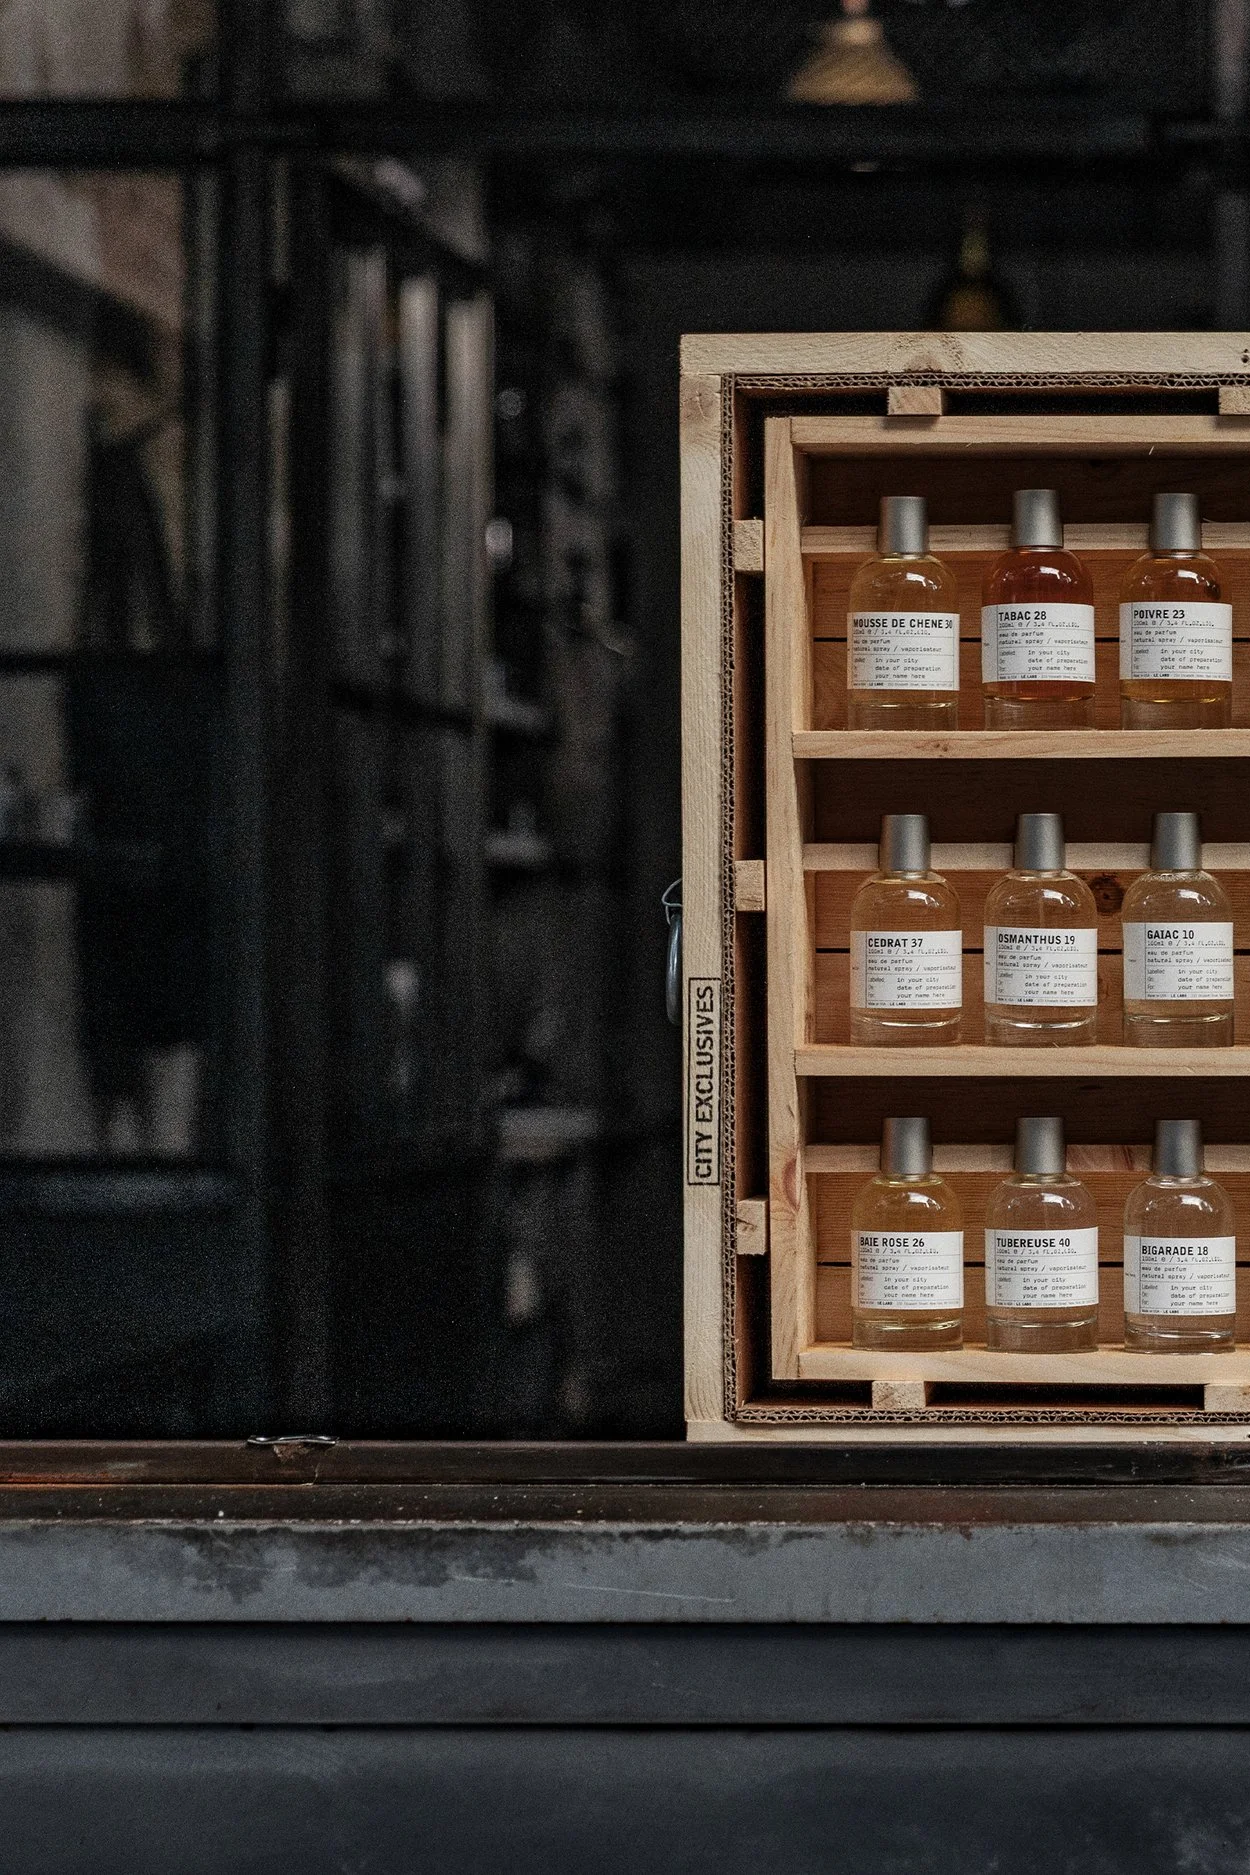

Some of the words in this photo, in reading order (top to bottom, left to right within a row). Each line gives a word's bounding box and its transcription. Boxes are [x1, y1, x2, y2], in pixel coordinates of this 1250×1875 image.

[999, 611, 1030, 621] TABAC
[1034, 611, 1046, 620] 28
[1134, 610, 1169, 619] POIVRE
[1173, 610, 1185, 618] 23
[853, 619, 887, 628] MOUSSE
[892, 619, 905, 627] DE
[910, 619, 943, 628] CHENE
[945, 620, 952, 628] 30
[999, 934, 1061, 944] OSMANTHUS
[1065, 936, 1075, 944] 19
[1147, 930, 1179, 939] GAIAC
[1183, 930, 1194, 939] 10
[868, 939, 908, 947] CEDRAT
[911, 939, 923, 947] 37
[696, 986, 714, 1123] EXCLUSIVES
[695, 1131, 712, 1179] CITY
[860, 1237, 878, 1246] BAIE
[882, 1238, 909, 1247] ROSE
[913, 1239, 924, 1247] 26
[997, 1238, 1055, 1248] TUBEREUSE
[1059, 1238, 1070, 1247] 40
[1142, 1246, 1193, 1255] BIGARADE
[1198, 1247, 1208, 1255] 18
